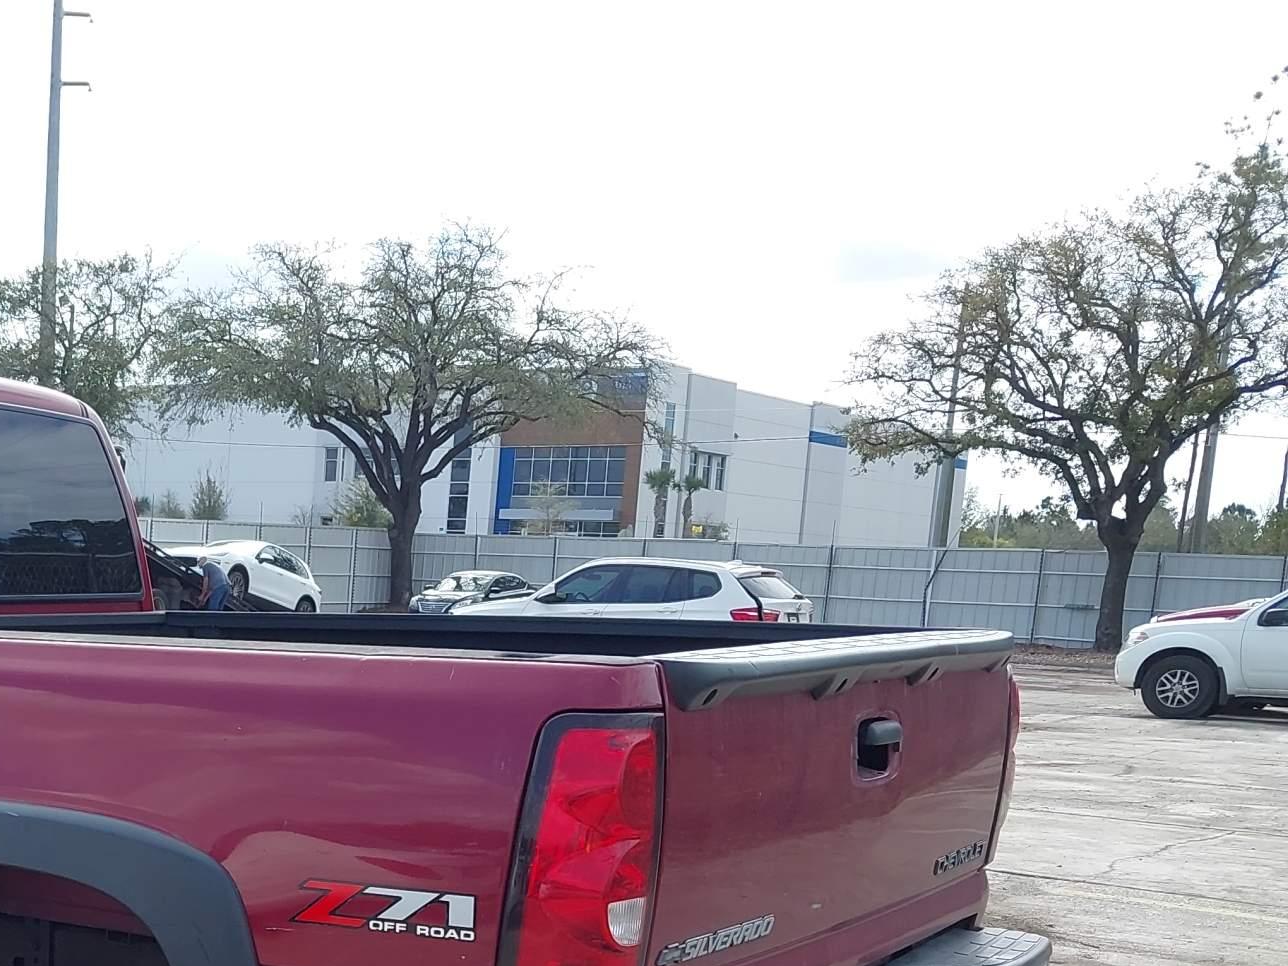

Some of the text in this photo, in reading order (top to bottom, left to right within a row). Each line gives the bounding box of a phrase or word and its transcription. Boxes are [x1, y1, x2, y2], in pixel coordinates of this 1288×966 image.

[290, 879, 477, 929] Z71
[368, 920, 476, 942] OFF ROAD
[681, 914, 775, 962] SILVERADO
